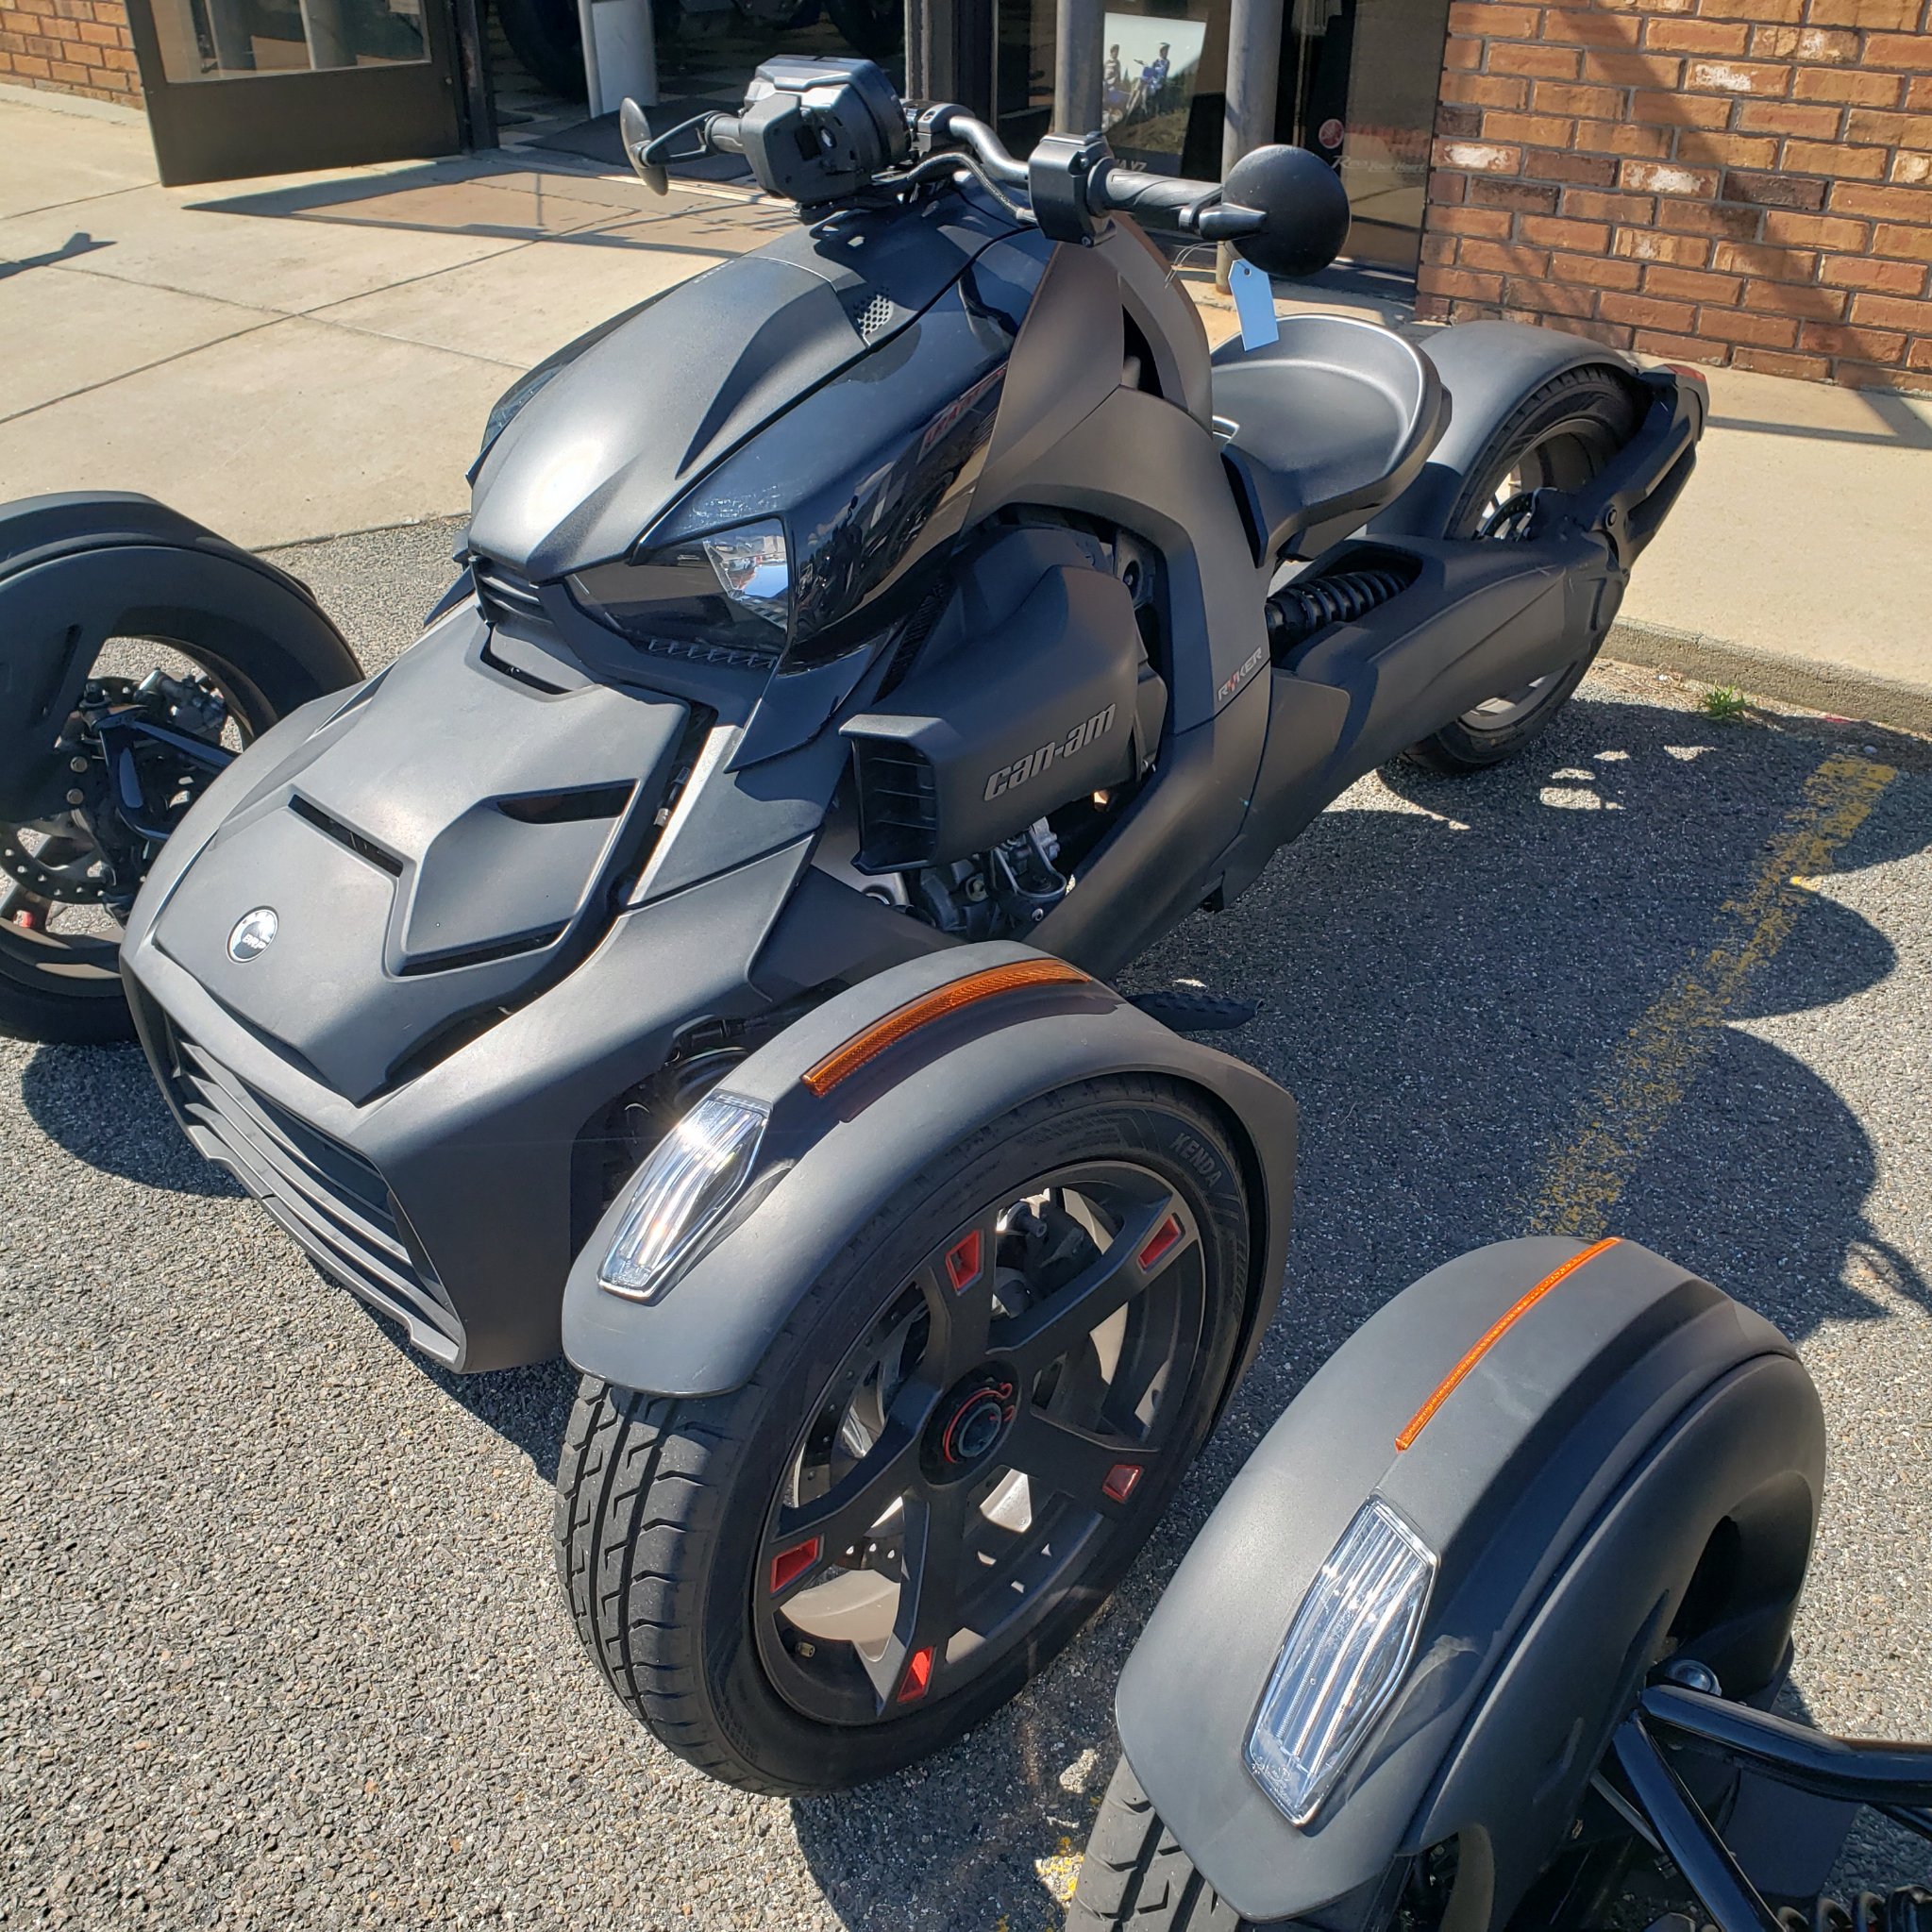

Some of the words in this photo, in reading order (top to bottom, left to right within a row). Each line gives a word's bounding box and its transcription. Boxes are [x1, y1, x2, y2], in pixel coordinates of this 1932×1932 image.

[1218, 647, 1262, 701] RYKER
[242, 933, 267, 949] BRP
[1170, 1133, 1222, 1187] KENDA
